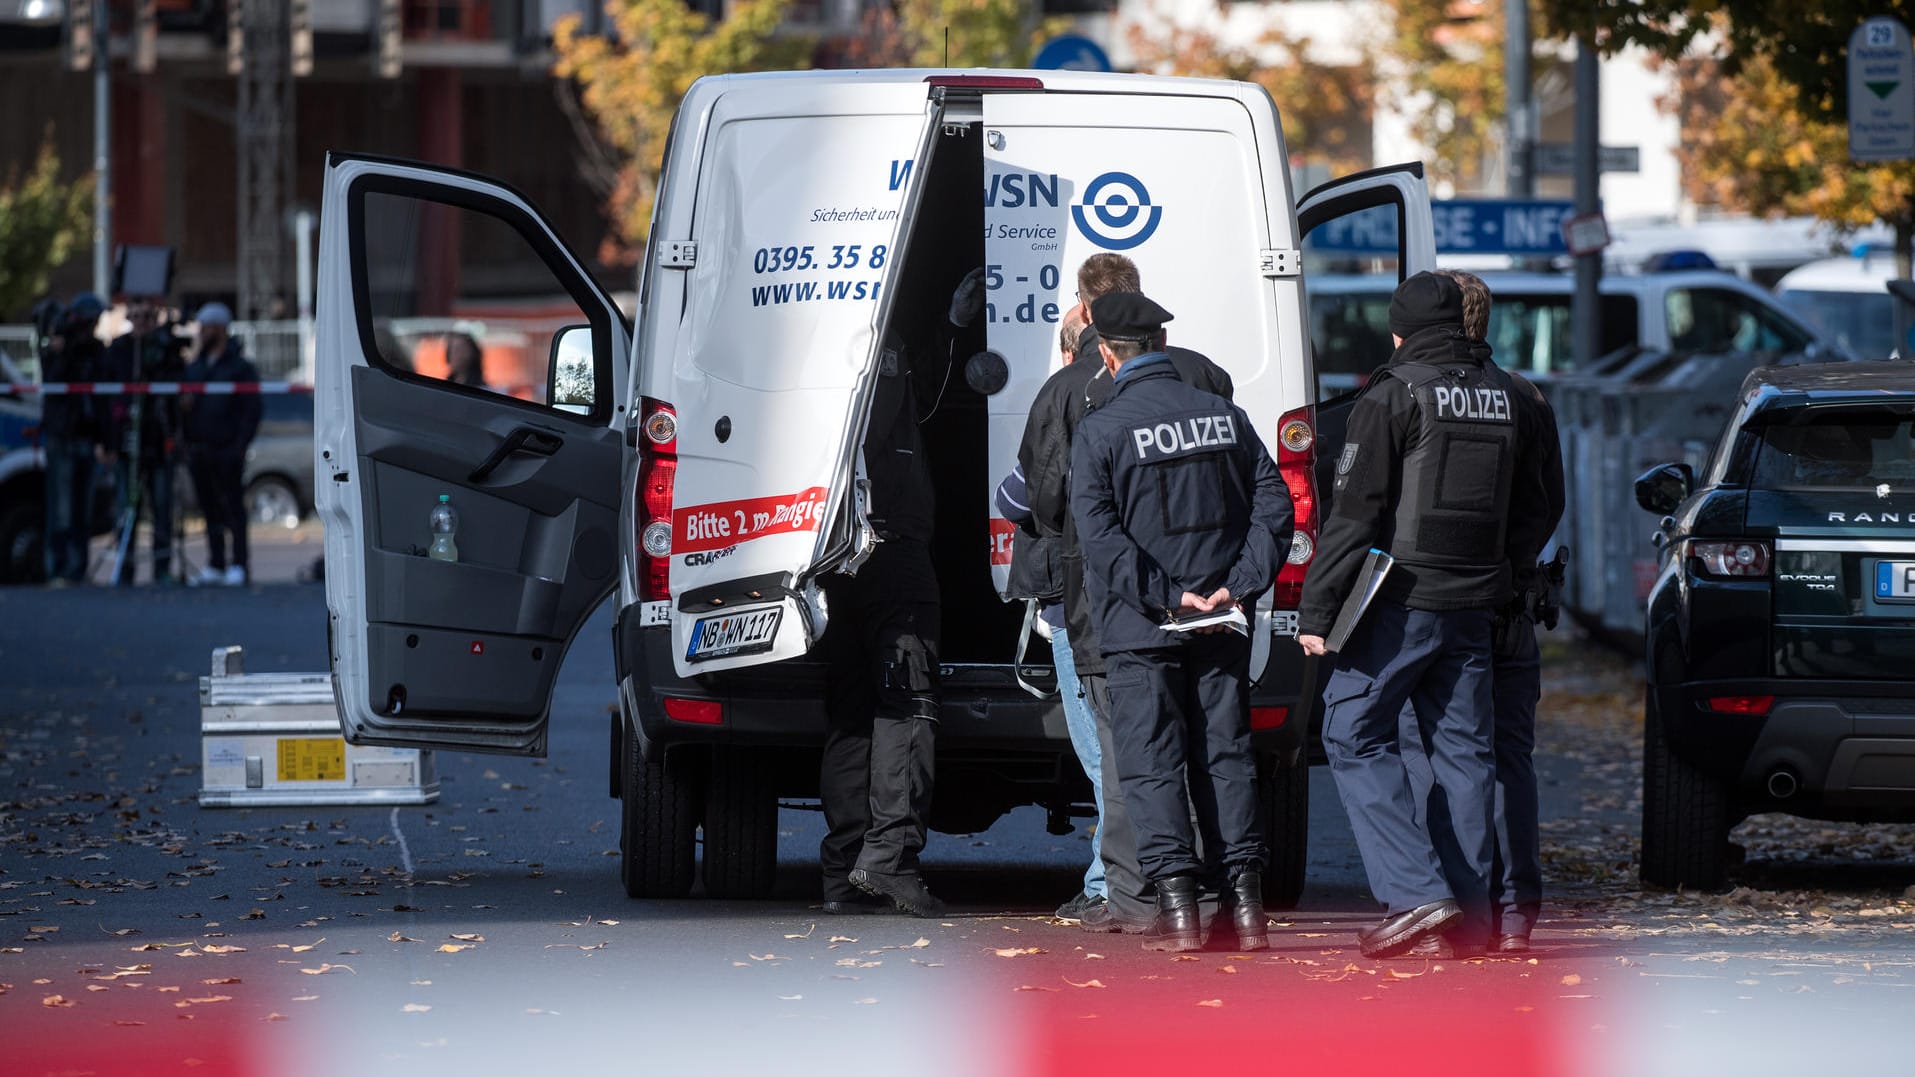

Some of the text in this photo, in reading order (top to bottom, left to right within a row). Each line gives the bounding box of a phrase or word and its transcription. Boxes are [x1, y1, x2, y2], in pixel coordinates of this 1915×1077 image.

[810, 207, 876, 222] Sicherheit
[998, 224, 1056, 239] Service
[754, 244, 887, 274] 0395. 35 8
[1031, 243, 1057, 251] GmbH
[1434, 386, 1511, 420] POLIZEI
[1133, 415, 1237, 459] POLIZEI
[687, 511, 730, 541] Bitte
[734, 509, 748, 535] 2
[752, 511, 770, 532] m
[697, 622, 720, 649] NB
